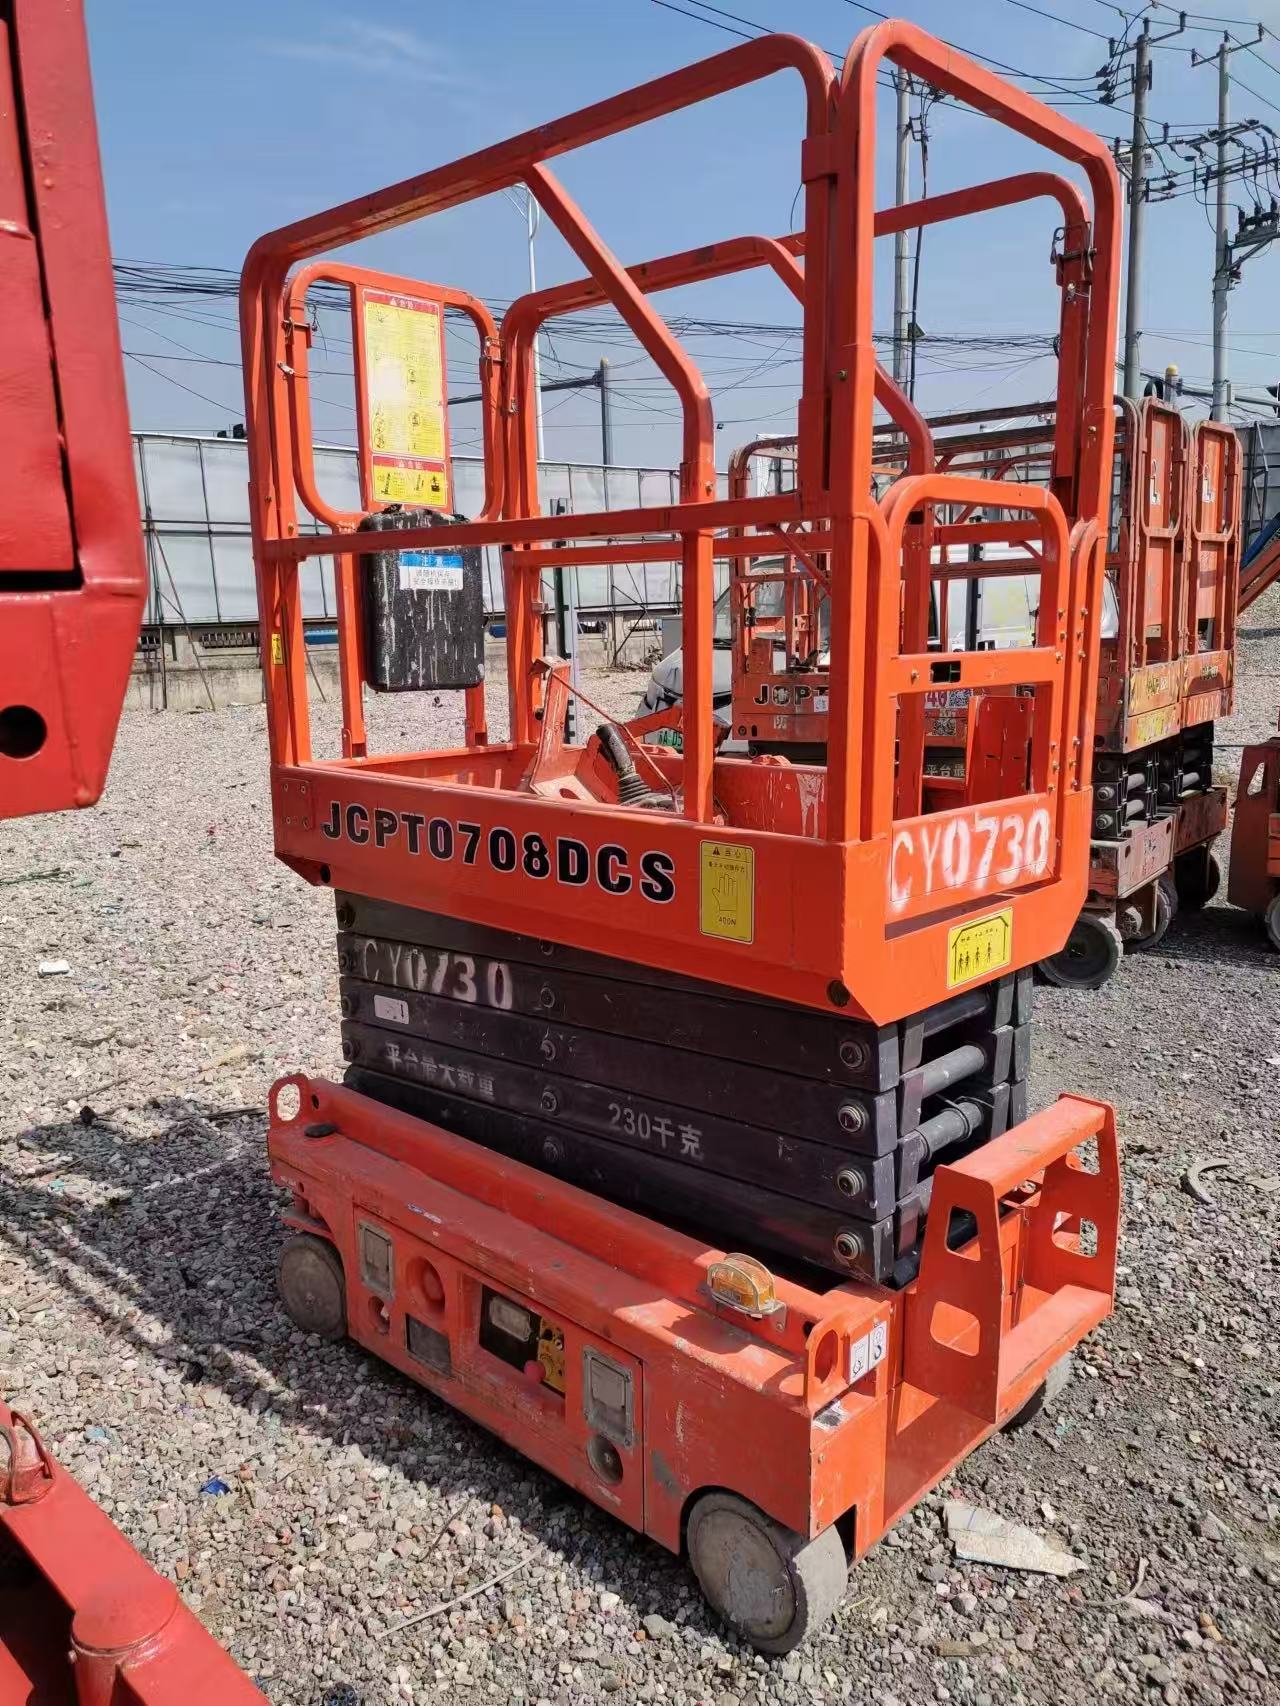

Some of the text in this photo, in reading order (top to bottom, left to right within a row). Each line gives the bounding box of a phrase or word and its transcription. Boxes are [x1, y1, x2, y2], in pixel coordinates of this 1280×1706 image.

[321, 801, 676, 904] JCPT0708DCS
[889, 809, 1050, 911] CY0730
[718, 917, 737, 926] 400N
[609, 1104, 704, 1160] 230千克
